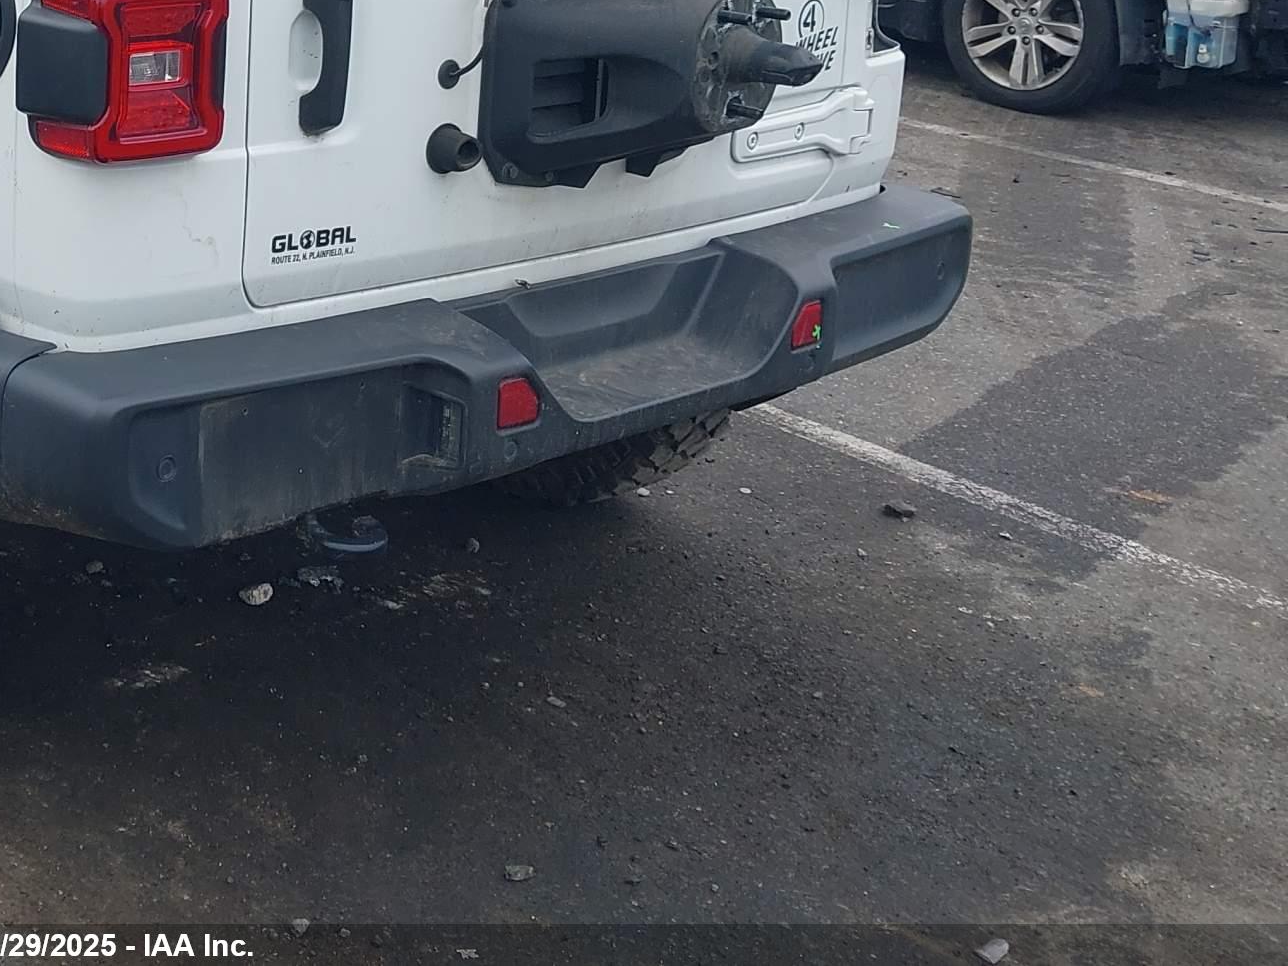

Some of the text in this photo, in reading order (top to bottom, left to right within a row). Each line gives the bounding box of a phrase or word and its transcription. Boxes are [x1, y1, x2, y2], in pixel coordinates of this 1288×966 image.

[803, 4, 816, 32] 4
[271, 226, 357, 253] GLOBAL
[271, 255, 291, 265] ROUTE
